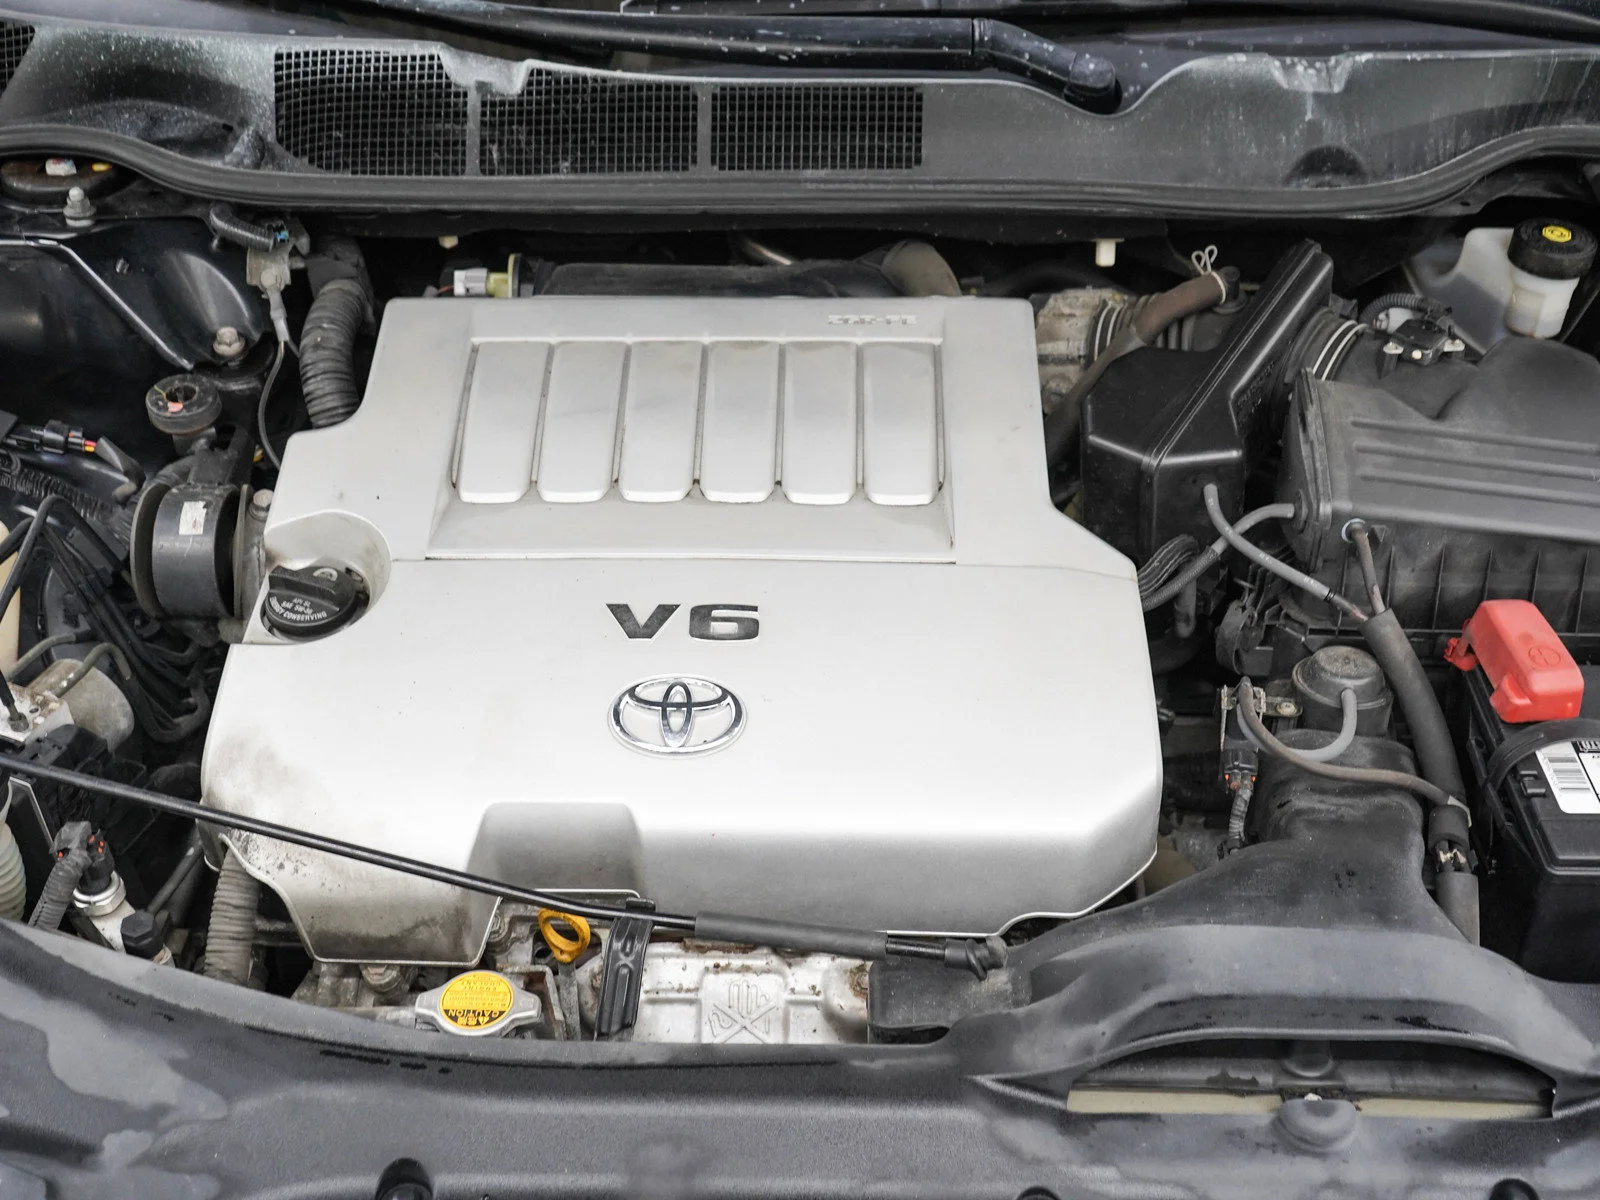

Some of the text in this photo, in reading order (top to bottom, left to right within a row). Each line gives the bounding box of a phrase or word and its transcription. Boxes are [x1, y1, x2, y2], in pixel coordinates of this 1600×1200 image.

[283, 610, 328, 621] CONSERVING
[605, 603, 760, 641] V6
[448, 1009, 500, 1018] CAUTION
